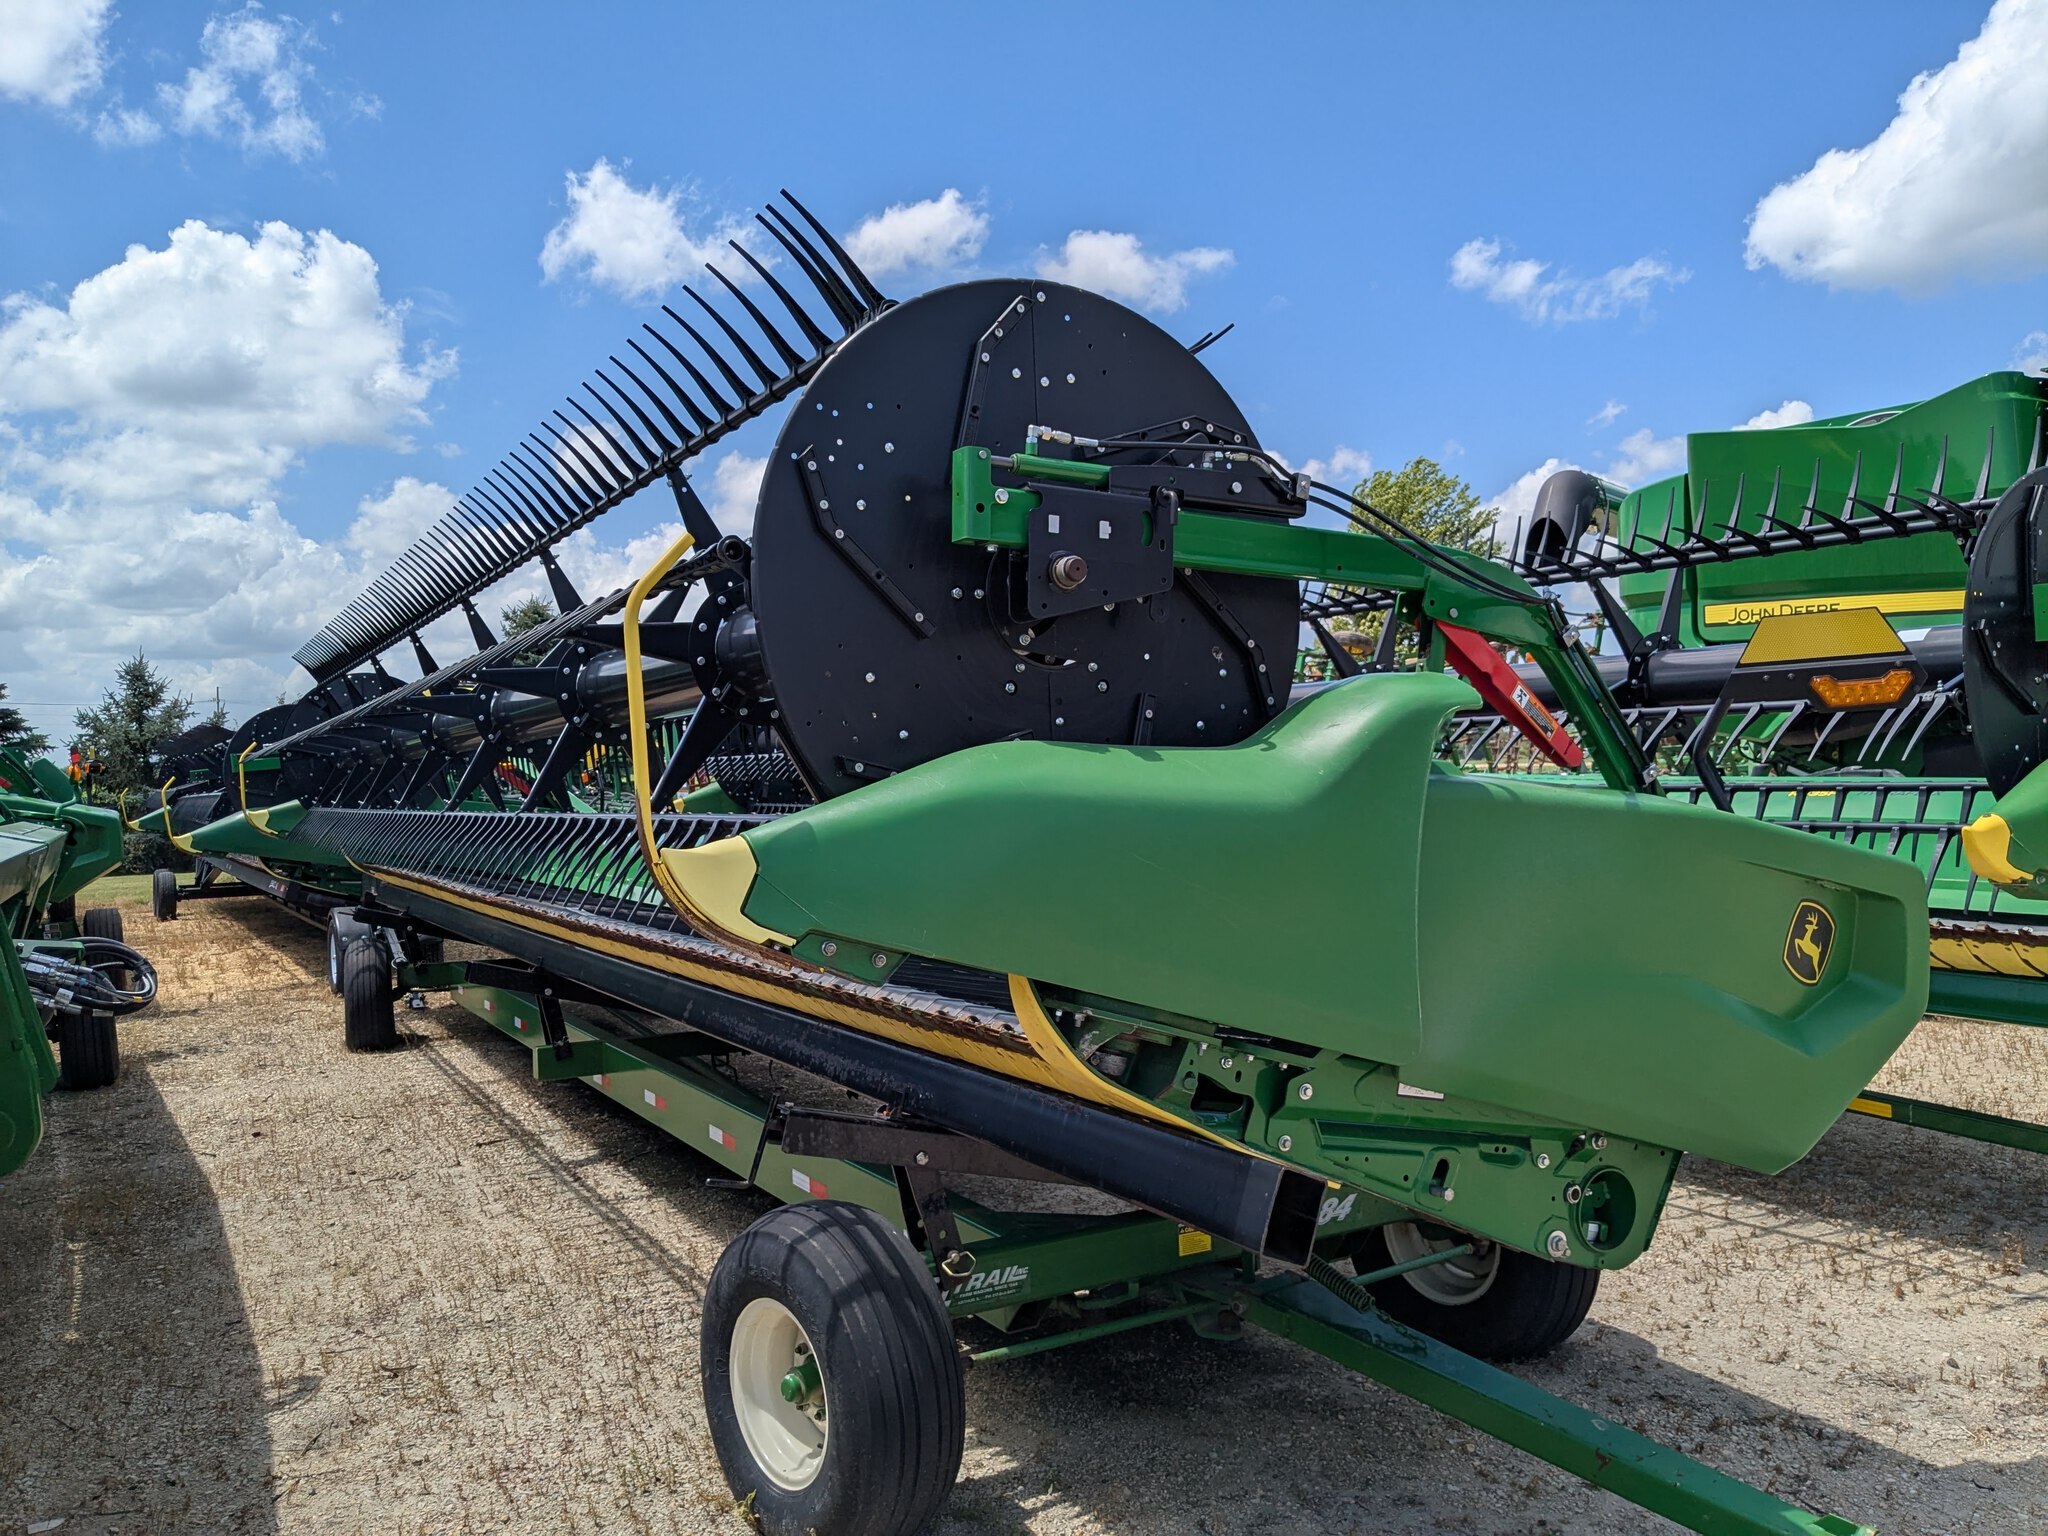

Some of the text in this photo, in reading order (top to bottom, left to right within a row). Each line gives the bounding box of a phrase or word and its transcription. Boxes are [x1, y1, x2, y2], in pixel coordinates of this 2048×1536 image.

[1728, 602, 1841, 623] JOHN DEERE
[1317, 1193, 1358, 1226] 84
